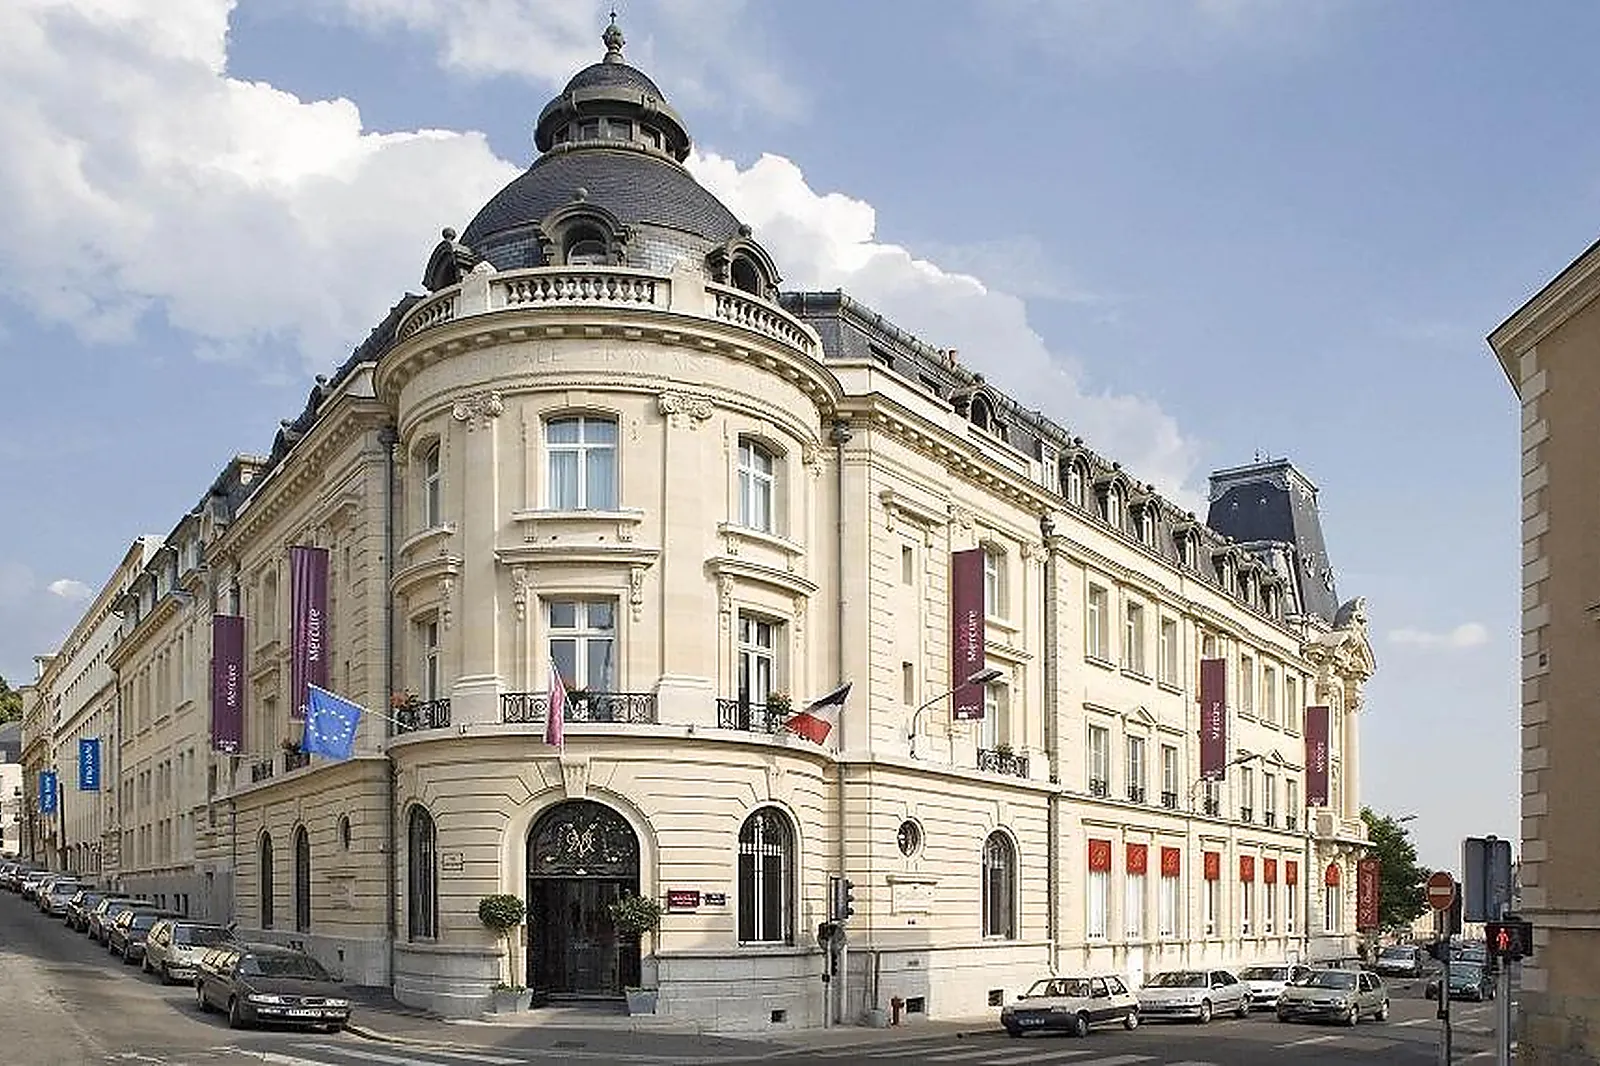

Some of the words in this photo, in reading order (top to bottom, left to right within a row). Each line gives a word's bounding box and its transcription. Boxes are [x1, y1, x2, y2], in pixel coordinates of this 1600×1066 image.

[308, 608, 321, 661] Mercure
[967, 610, 978, 662] Mercure
[226, 663, 237, 706] Mercure
